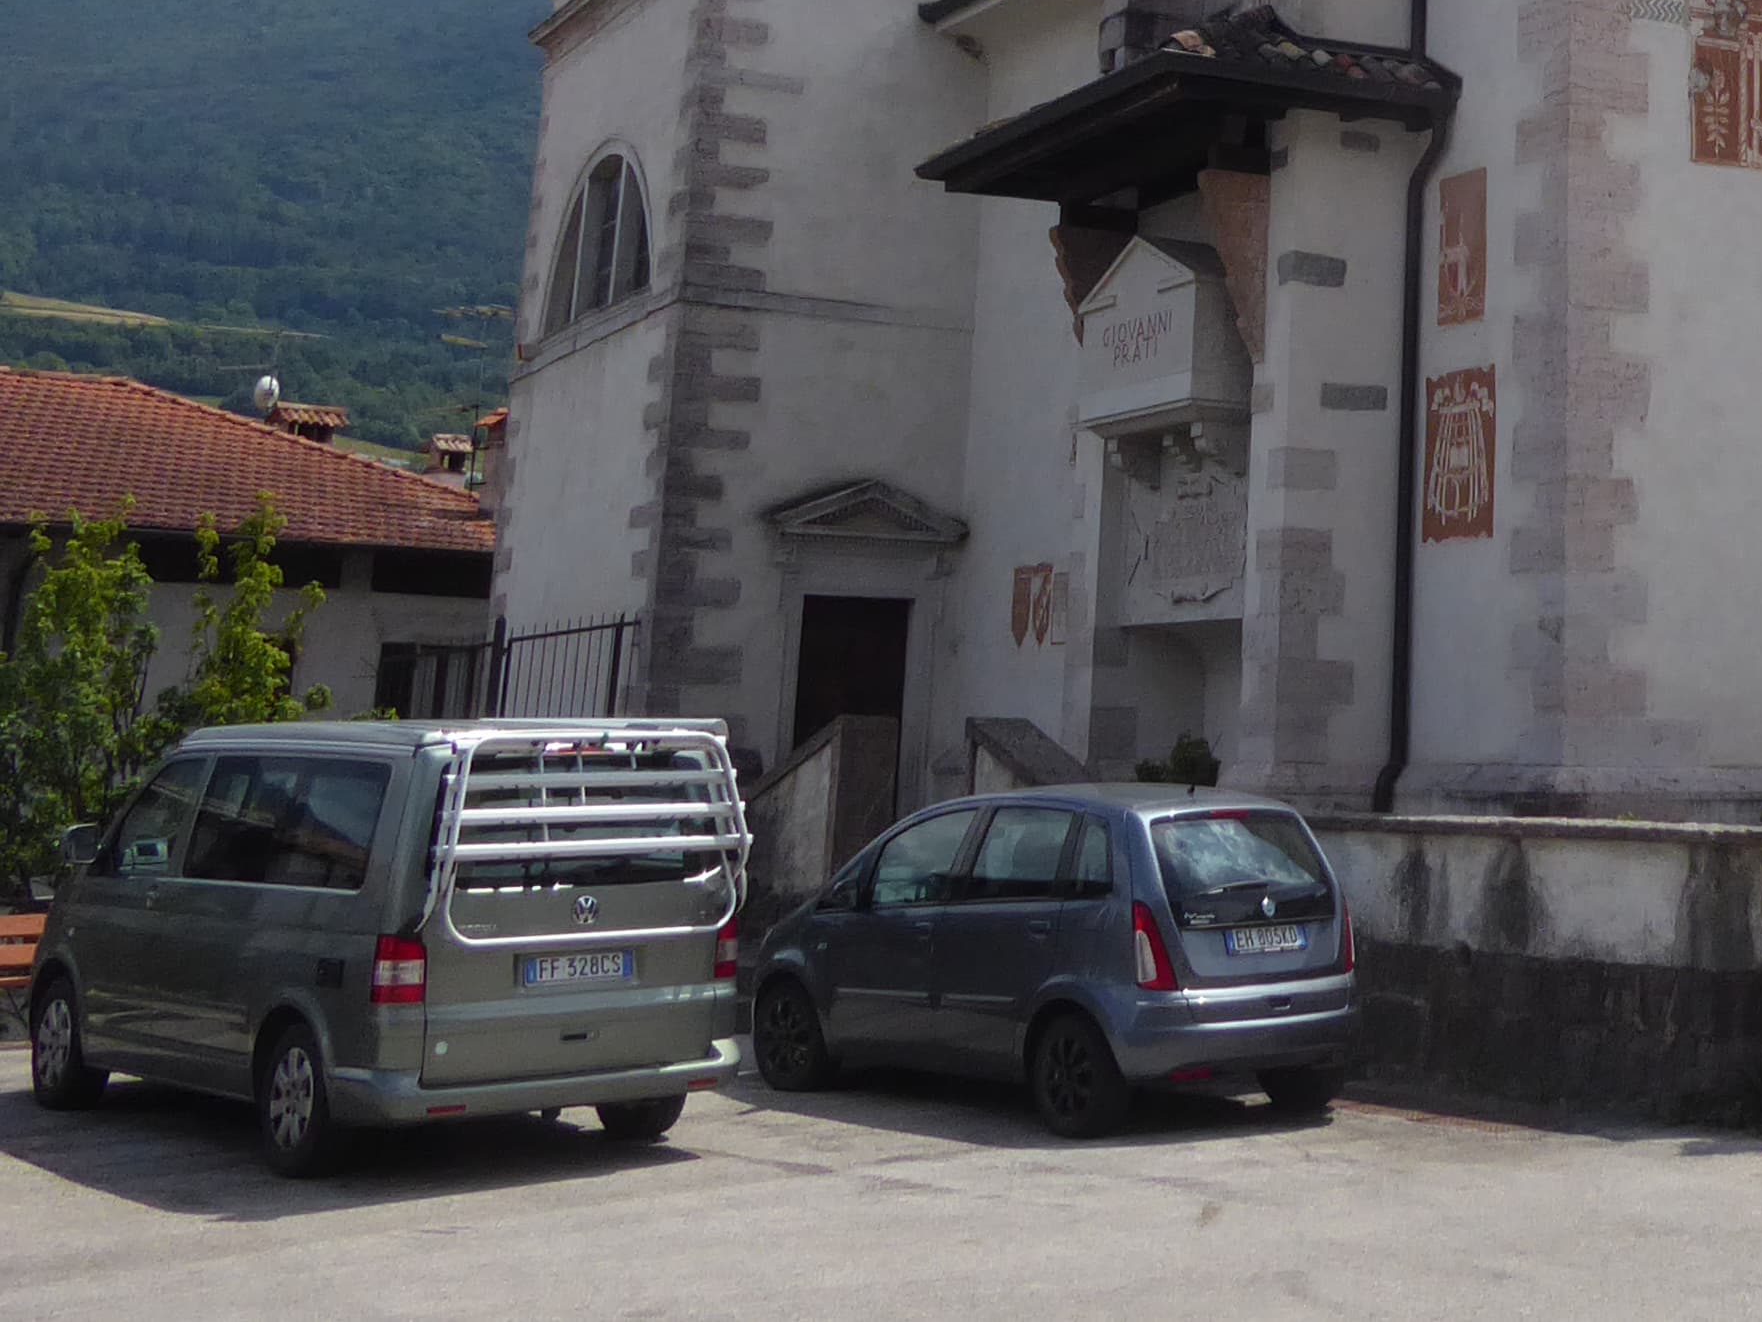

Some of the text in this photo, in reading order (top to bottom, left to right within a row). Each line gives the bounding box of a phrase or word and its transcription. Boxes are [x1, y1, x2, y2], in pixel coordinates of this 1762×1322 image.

[1103, 309, 1173, 348] GIOVANNI
[1113, 336, 1158, 368] PRATI
[538, 954, 622, 980] FF 328CS
